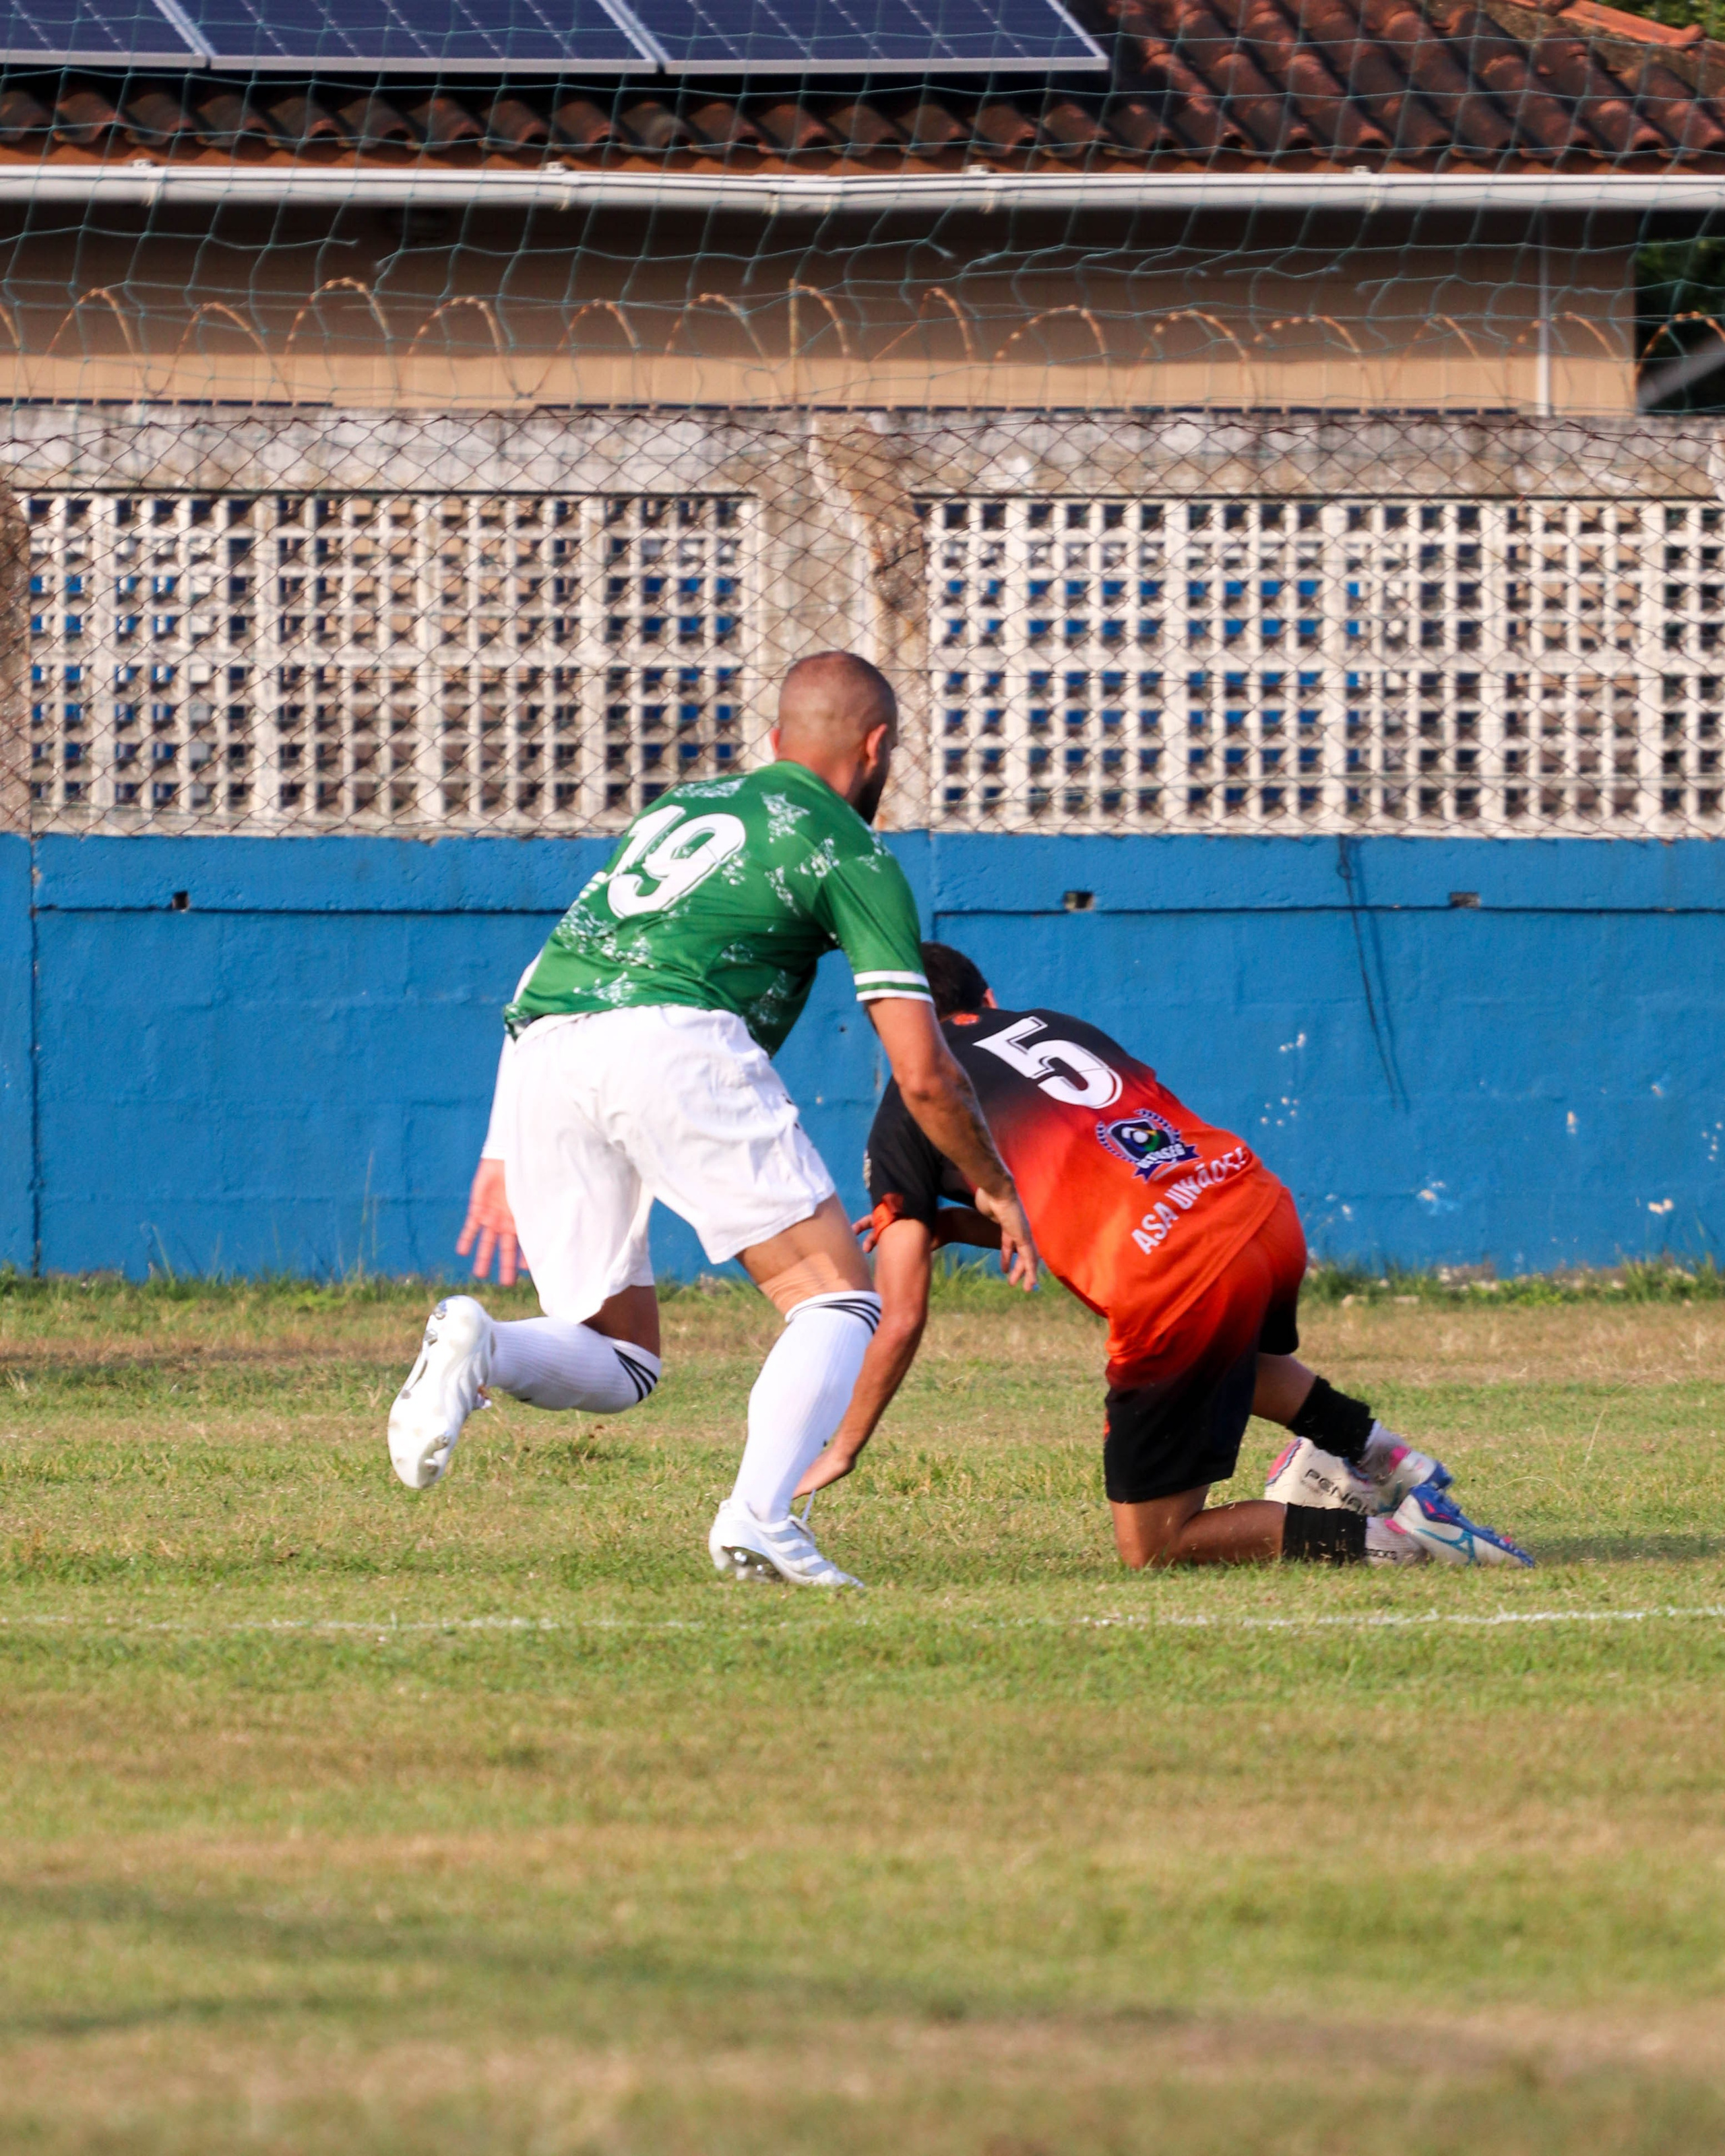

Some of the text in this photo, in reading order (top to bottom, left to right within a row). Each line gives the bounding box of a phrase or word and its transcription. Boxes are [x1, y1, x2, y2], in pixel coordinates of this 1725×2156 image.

[606, 804, 746, 918] 19
[973, 1016, 1123, 1109] 5
[1131, 1202, 1179, 1255] ASA
